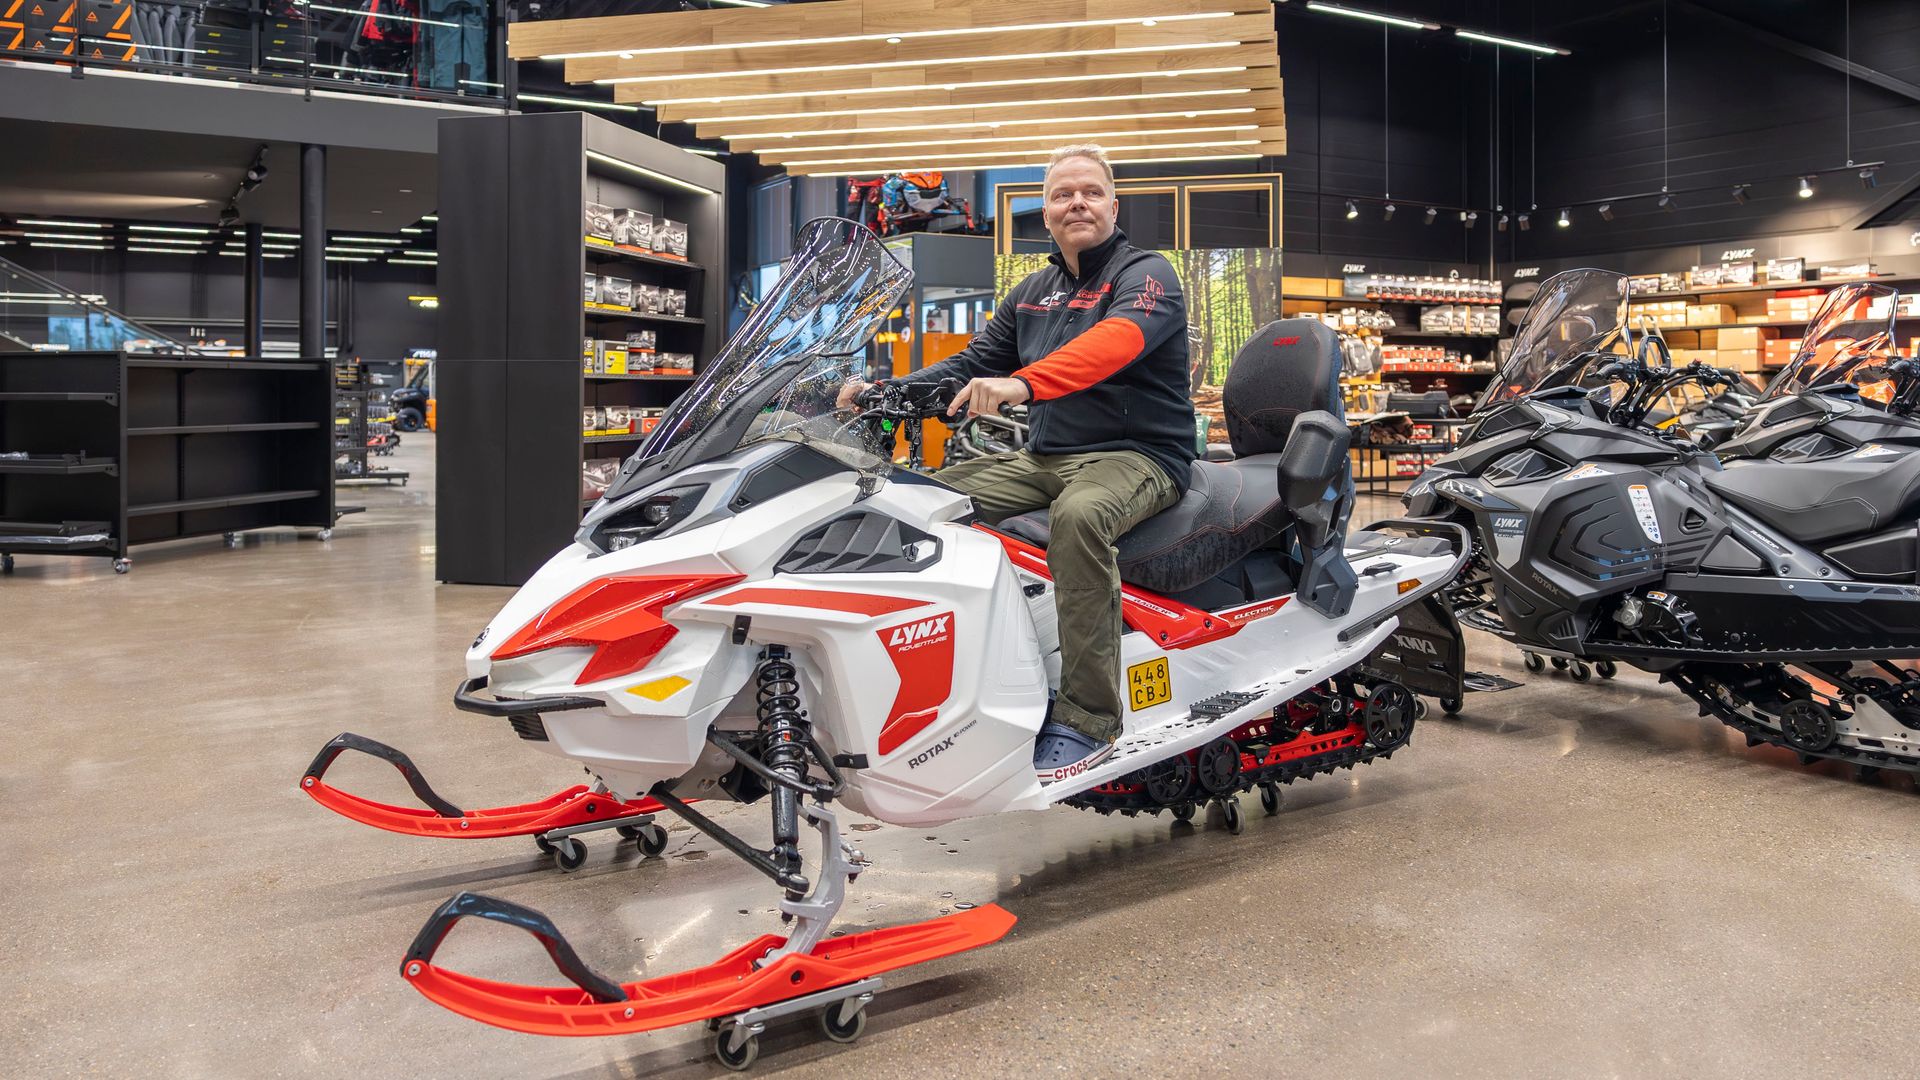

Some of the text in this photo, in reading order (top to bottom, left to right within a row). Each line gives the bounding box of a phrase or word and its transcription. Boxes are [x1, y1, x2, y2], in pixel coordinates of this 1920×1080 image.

[1721, 248, 1756, 261] LYNX
[1342, 263, 1366, 274] LYNX
[1513, 267, 1541, 279] LYNX
[1494, 517, 1522, 528] LYNX
[1531, 571, 1559, 596] ROTAX
[1234, 605, 1275, 620] ELECTRIC
[889, 616, 950, 647] LYNX
[898, 635, 948, 653] ADVENTURE
[1133, 663, 1165, 685] 448
[1135, 681, 1167, 705] CBJ
[908, 736, 955, 770] ROTAX
[1054, 759, 1089, 780] crocs
